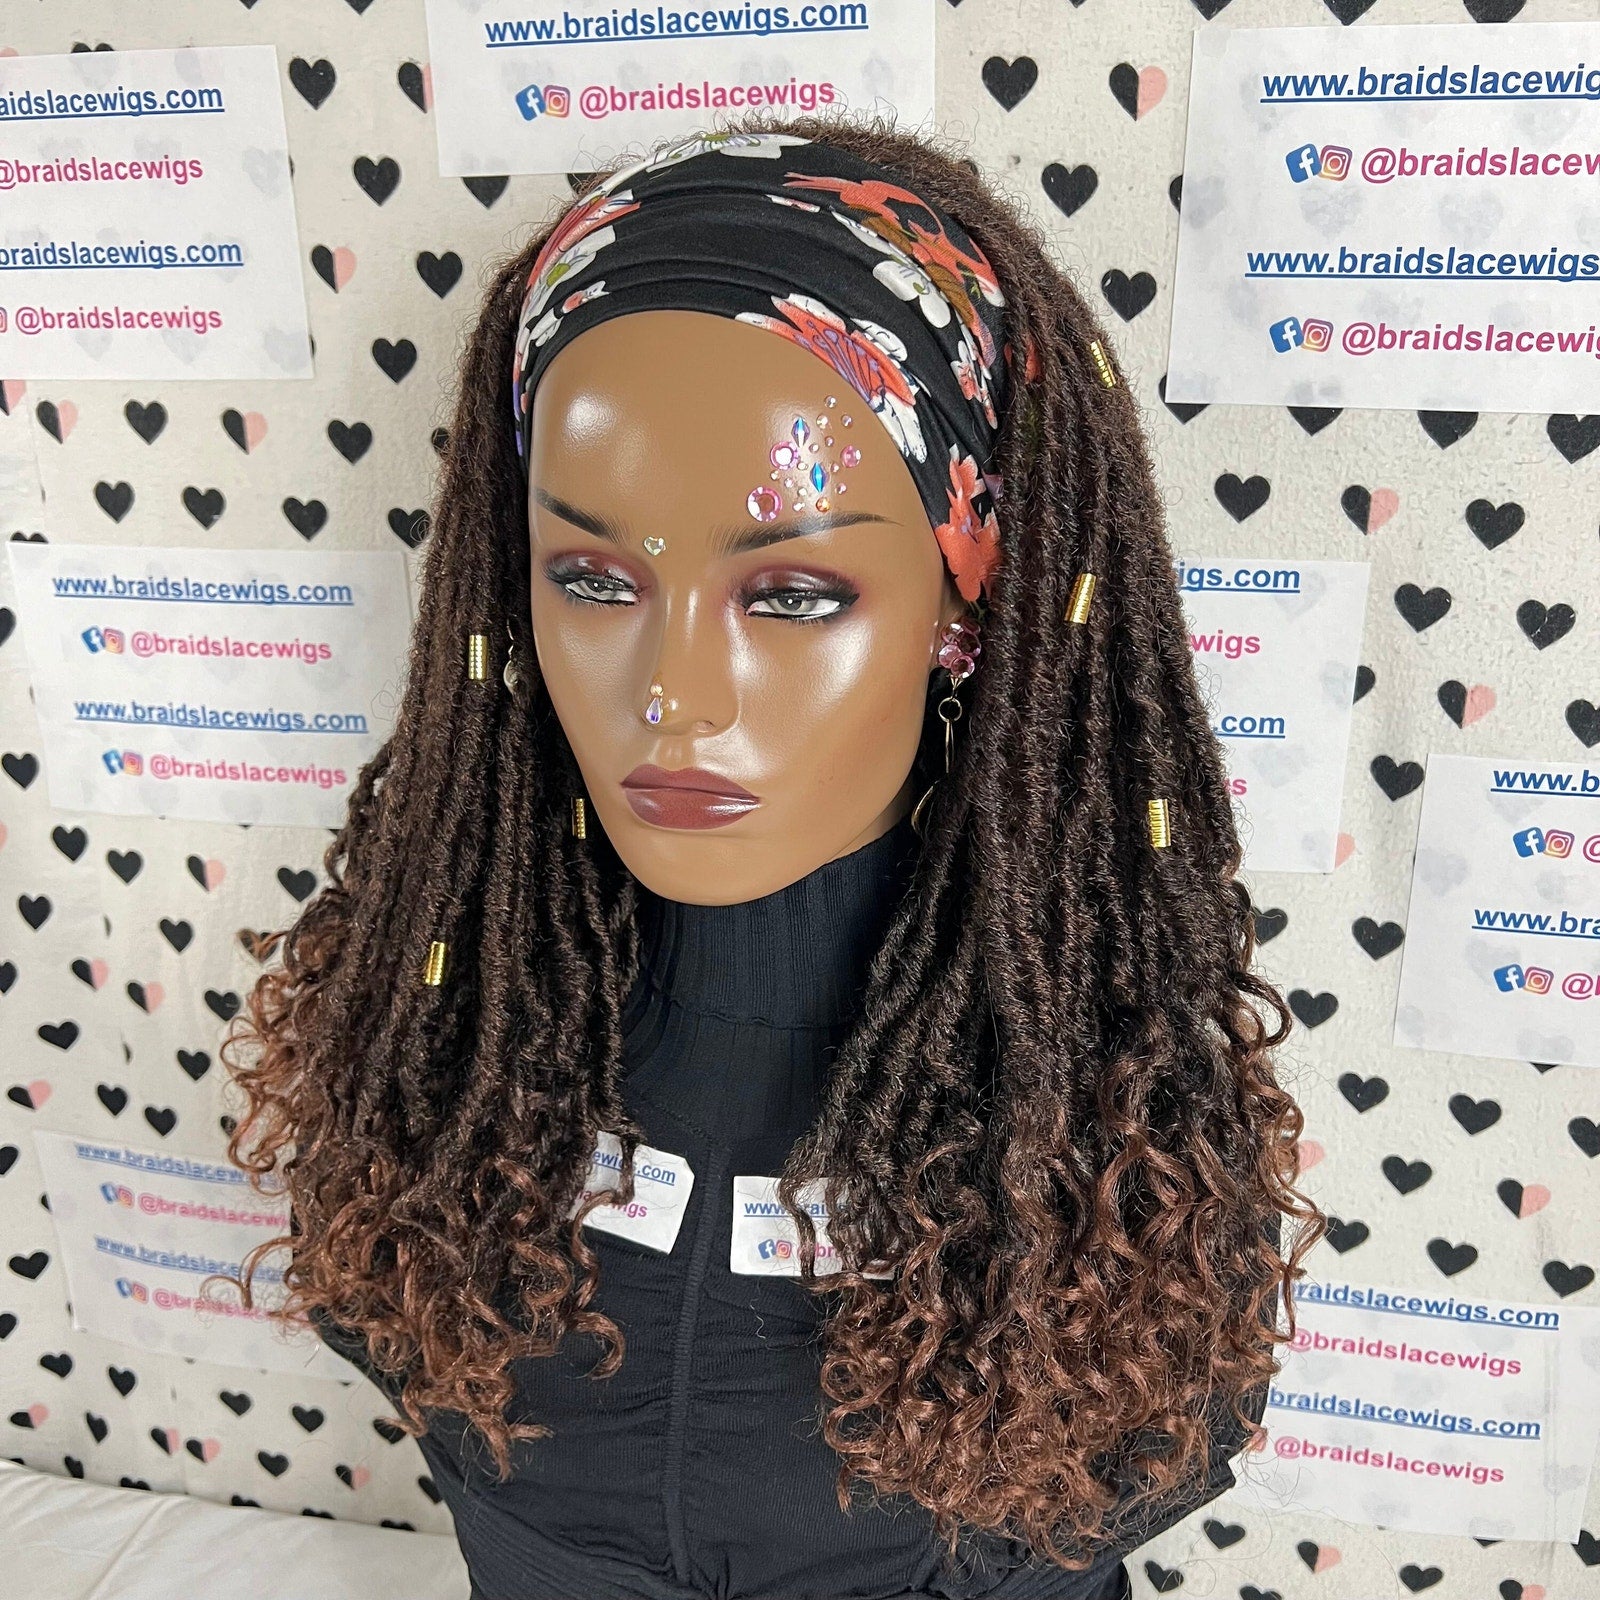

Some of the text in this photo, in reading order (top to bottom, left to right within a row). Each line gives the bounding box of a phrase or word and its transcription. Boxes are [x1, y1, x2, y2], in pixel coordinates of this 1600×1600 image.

[485, 2, 867, 46] www.braidslacewigs.com
[580, 77, 835, 119] @braidslacewigs
[15, 306, 223, 335] @braidslacewigs
[1342, 322, 1600, 360] @braidslacewi
[53, 575, 353, 604] www.braidslacewigs.com
[131, 630, 333, 664] @braidslacewigs
[74, 700, 368, 732] www.braidslacewigs.com
[150, 753, 347, 789] @braidslacewigs
[1274, 1436, 1505, 1485] @braidslacewigs
